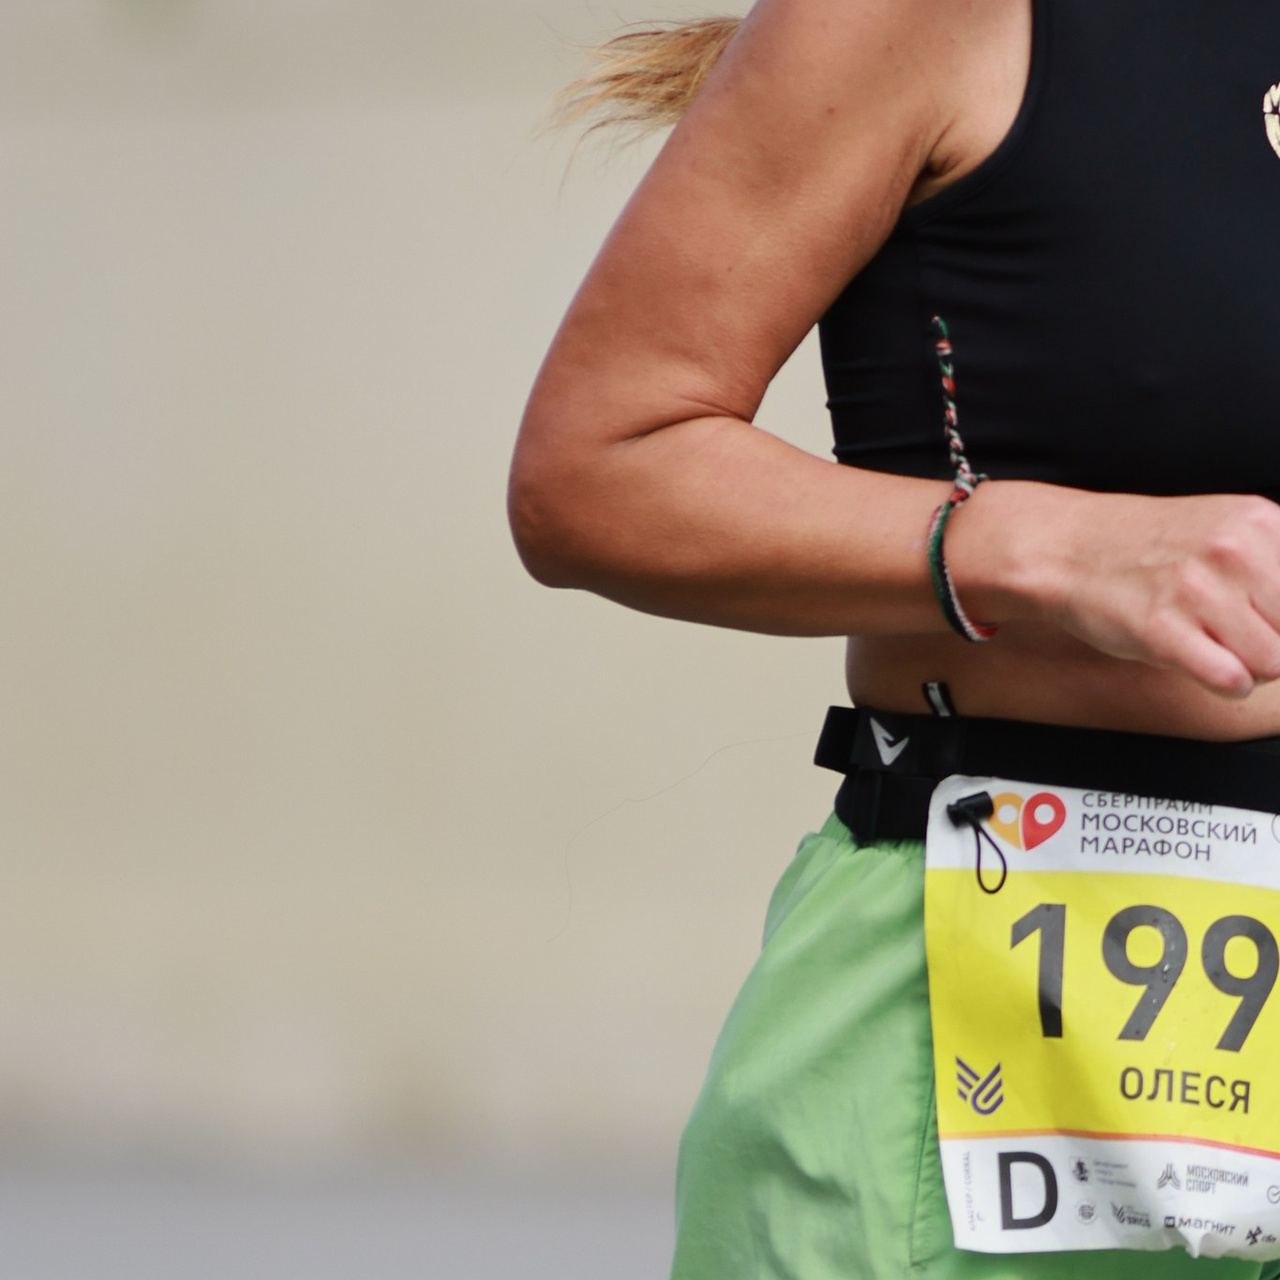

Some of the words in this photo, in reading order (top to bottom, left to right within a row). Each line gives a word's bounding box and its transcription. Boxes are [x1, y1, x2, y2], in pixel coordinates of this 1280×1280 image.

[1081, 813, 1257, 845] МОСКОВСКИЙ
[1080, 836, 1211, 862] МАРАФОН
[1119, 1066, 1252, 1115] ОЛЕСЯ
[1186, 1164, 1249, 1188] МОСКОВСКИЙ
[1186, 1178, 1217, 1195] СПОРТ
[998, 1151, 1059, 1231] D
